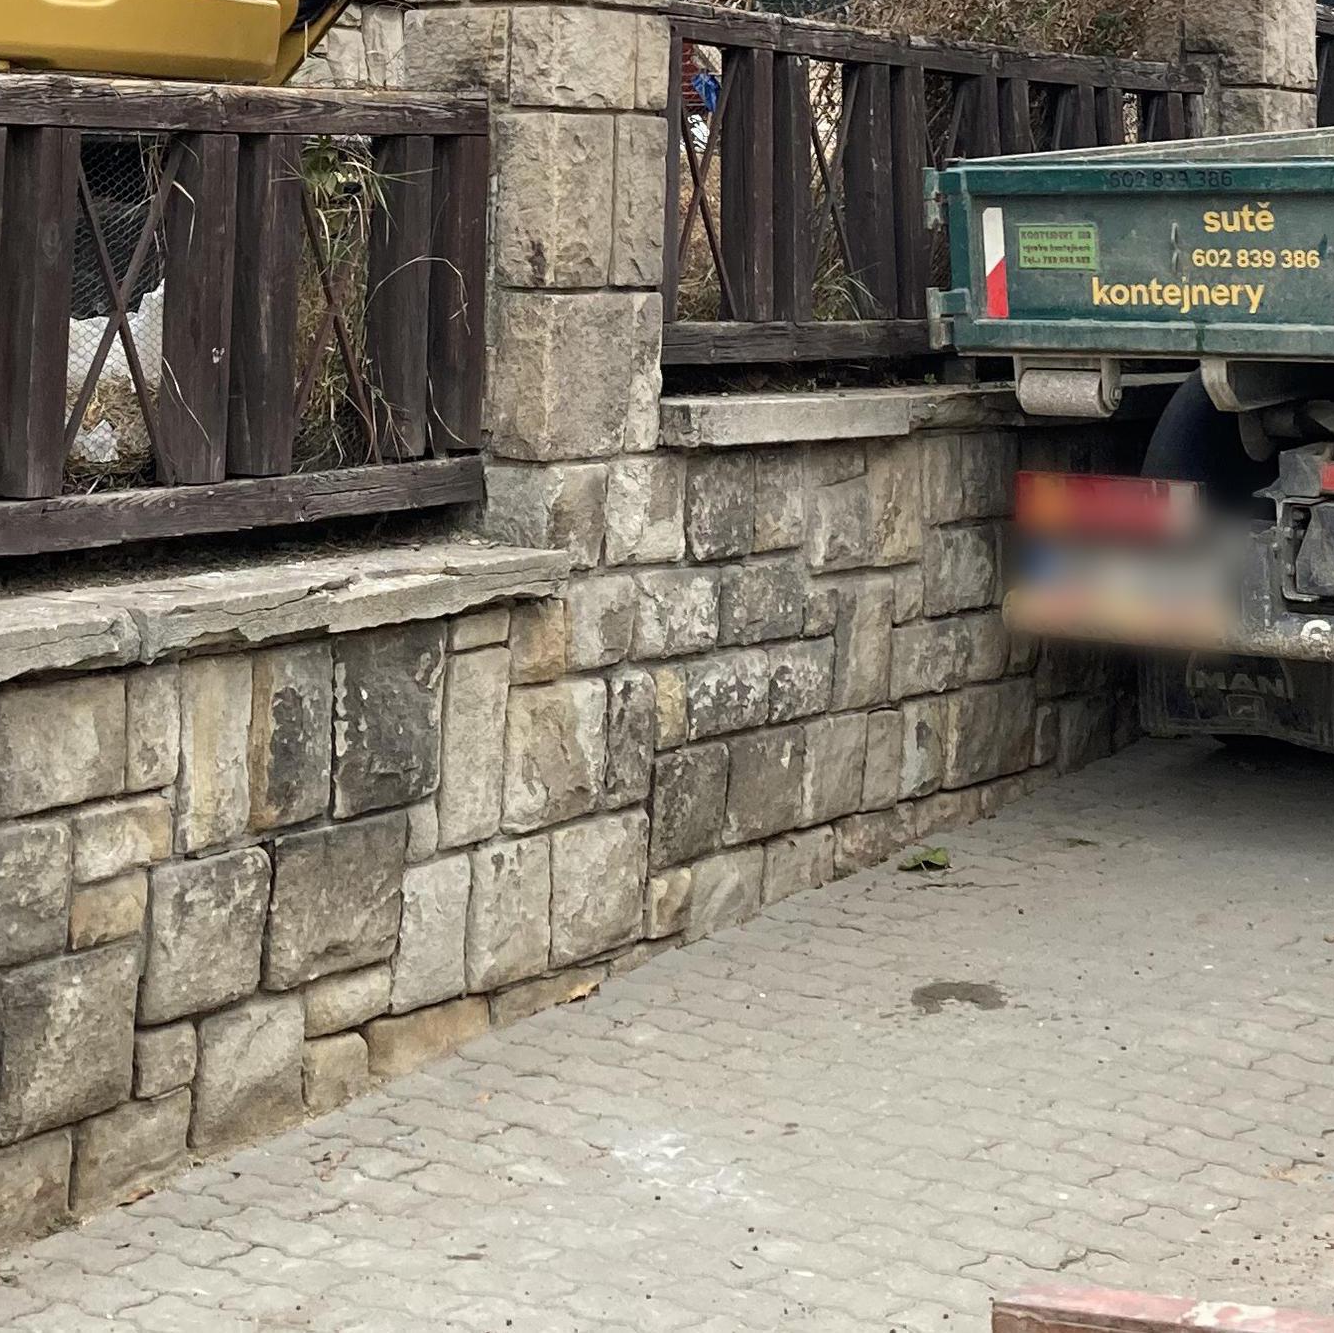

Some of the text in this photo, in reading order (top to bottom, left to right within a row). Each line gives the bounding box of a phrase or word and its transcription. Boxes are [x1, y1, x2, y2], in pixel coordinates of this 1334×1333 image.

[1203, 201, 1275, 233] sutě
[1192, 248, 1321, 269] 602 839 386
[1091, 276, 1265, 314] kontejnery
[1194, 669, 1286, 699] MAN
